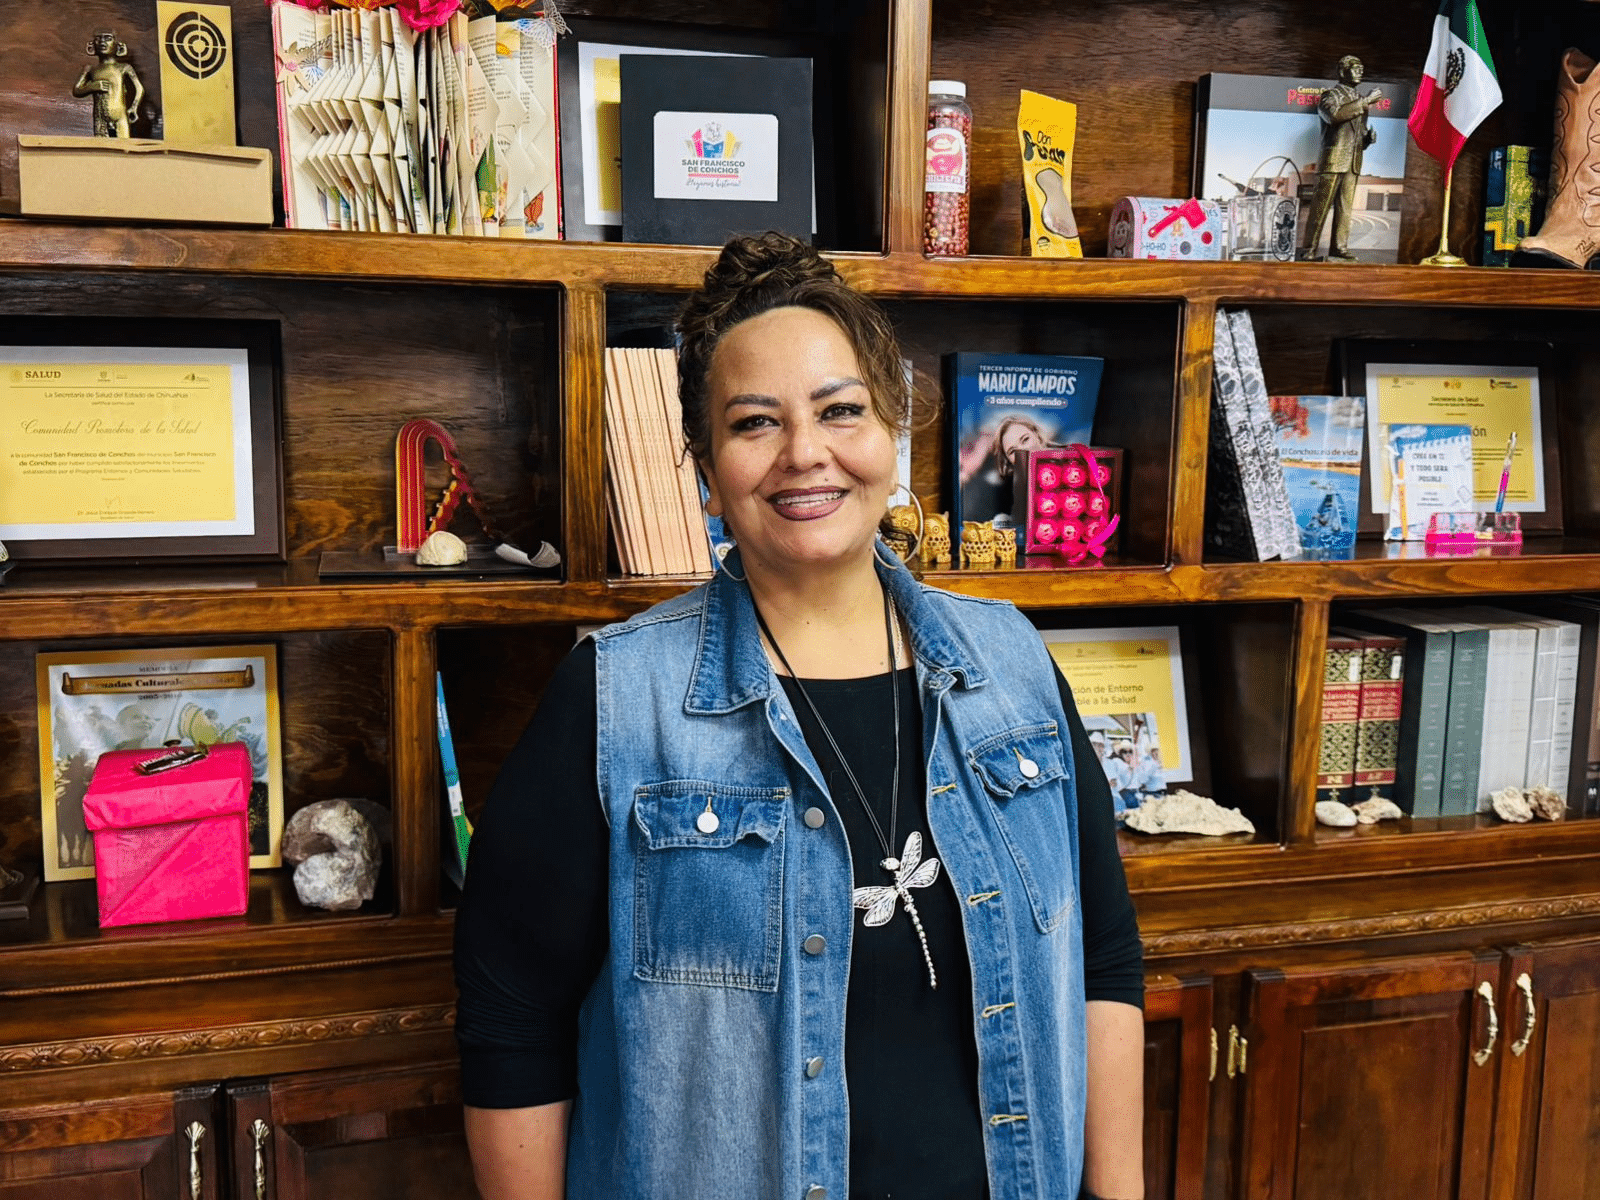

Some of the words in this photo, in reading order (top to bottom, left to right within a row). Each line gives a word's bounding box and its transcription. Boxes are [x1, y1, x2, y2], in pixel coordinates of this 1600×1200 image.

[700, 159, 745, 168] FRANCISCO
[700, 166, 739, 174] CONCHOS
[25, 371, 62, 379] SALUD
[1045, 368, 1078, 376] GOBIERNO
[978, 372, 1017, 392] MARU
[1018, 373, 1077, 395] CAMPOS
[996, 396, 1015, 405] años
[1016, 397, 1062, 407] cumpliendo
[20, 418, 83, 434] Comunidad
[140, 420, 151, 434] de
[1093, 685, 1105, 694] de
[1107, 684, 1144, 693] Entorno
[1111, 695, 1136, 704] Salud
